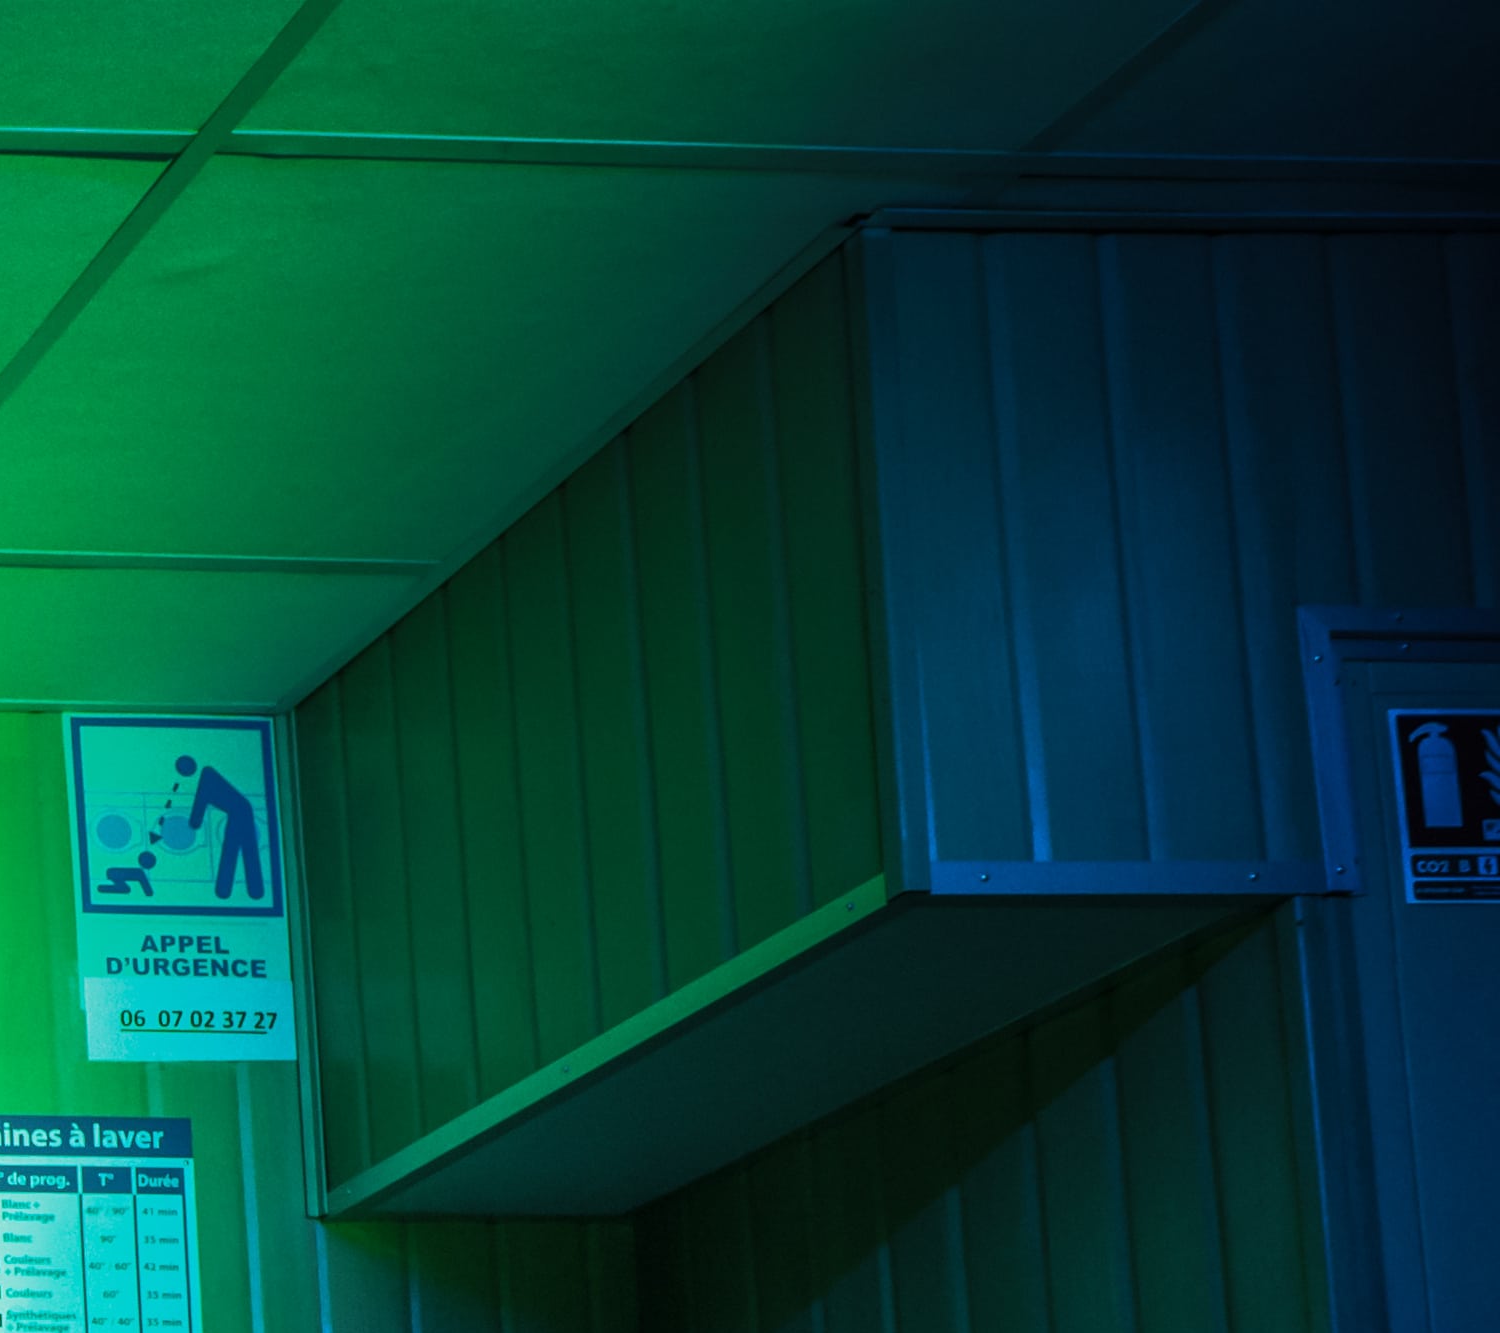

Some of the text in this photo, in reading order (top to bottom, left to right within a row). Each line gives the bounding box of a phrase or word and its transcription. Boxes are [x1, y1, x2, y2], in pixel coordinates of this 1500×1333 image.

[140, 934, 231, 955] APPEL
[105, 956, 268, 979] D'URGENCE
[120, 1009, 279, 1031] 06 07 02 37 27
[67, 1121, 86, 1148] à
[91, 1122, 164, 1149] laver
